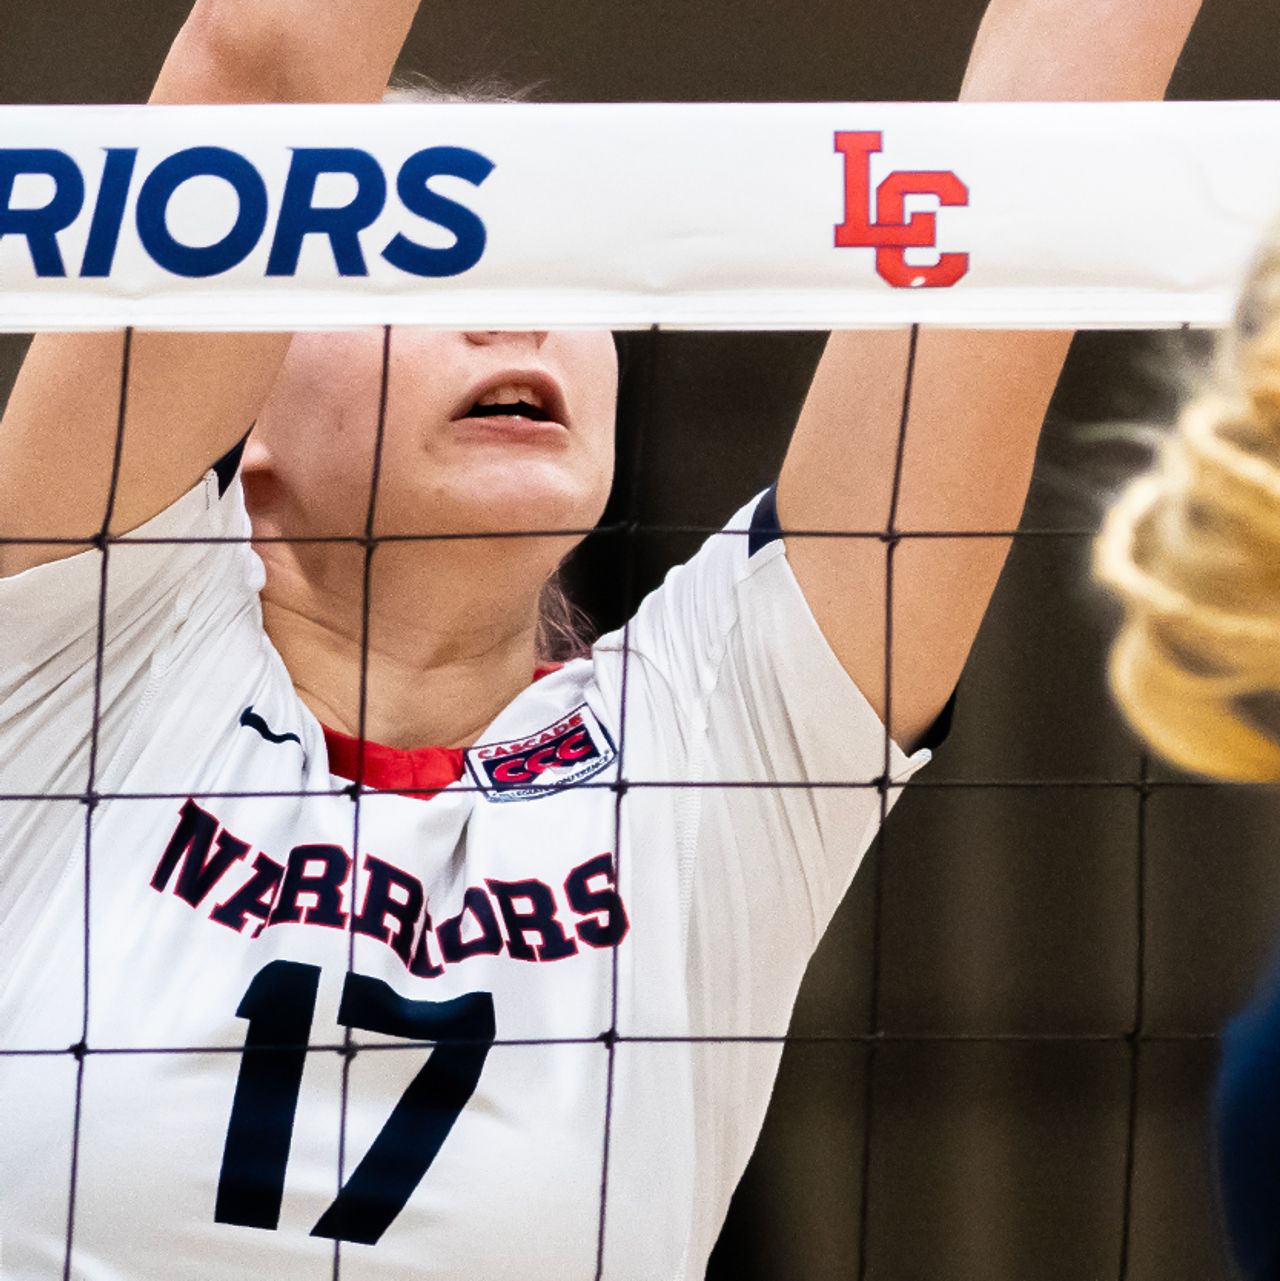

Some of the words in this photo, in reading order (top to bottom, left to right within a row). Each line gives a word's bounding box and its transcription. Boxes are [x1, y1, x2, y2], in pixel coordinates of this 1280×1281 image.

[834, 132, 968, 289] LC
[477, 712, 584, 760] CASCADE
[492, 729, 593, 783] CCC
[214, 959, 497, 1246] 17
